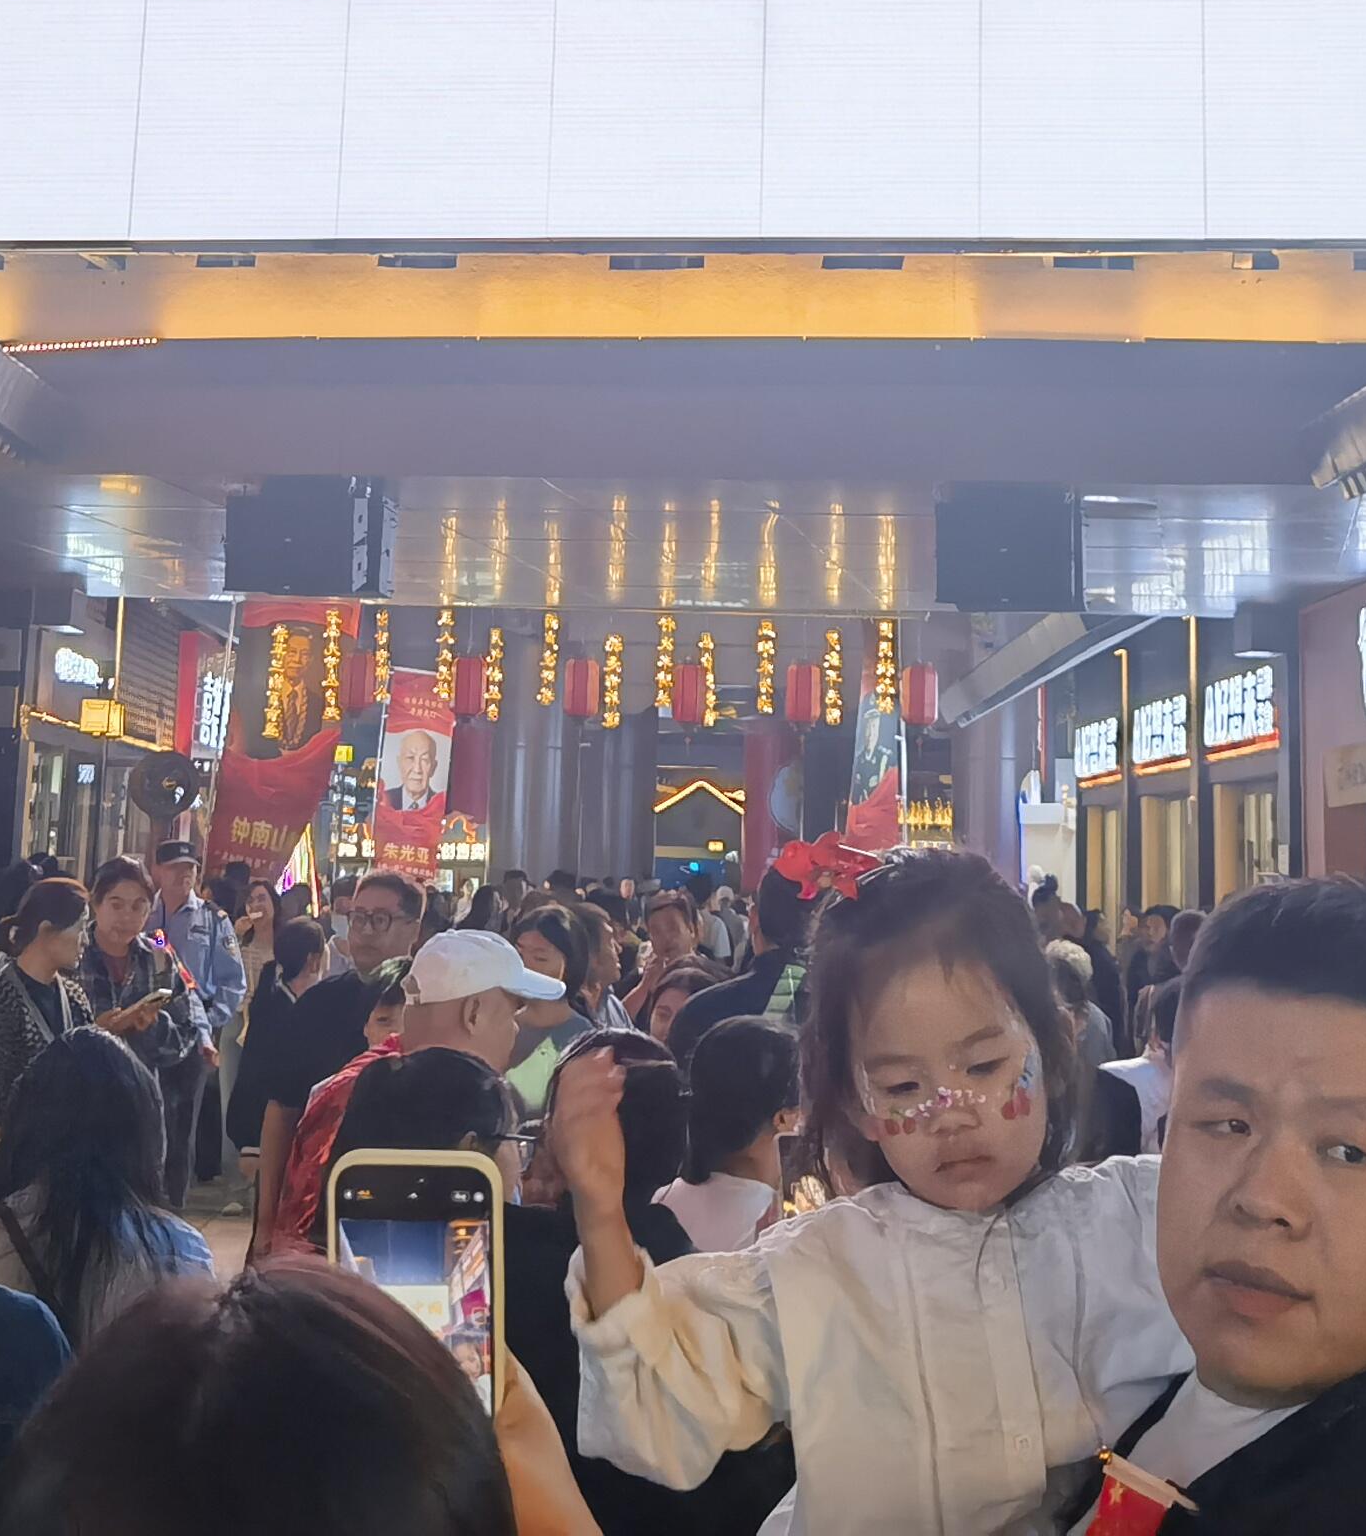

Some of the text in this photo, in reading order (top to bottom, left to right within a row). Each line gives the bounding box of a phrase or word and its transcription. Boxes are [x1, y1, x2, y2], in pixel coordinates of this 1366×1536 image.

[230, 816, 293, 852] 钟南山
[383, 842, 429, 864] 朱光亚
